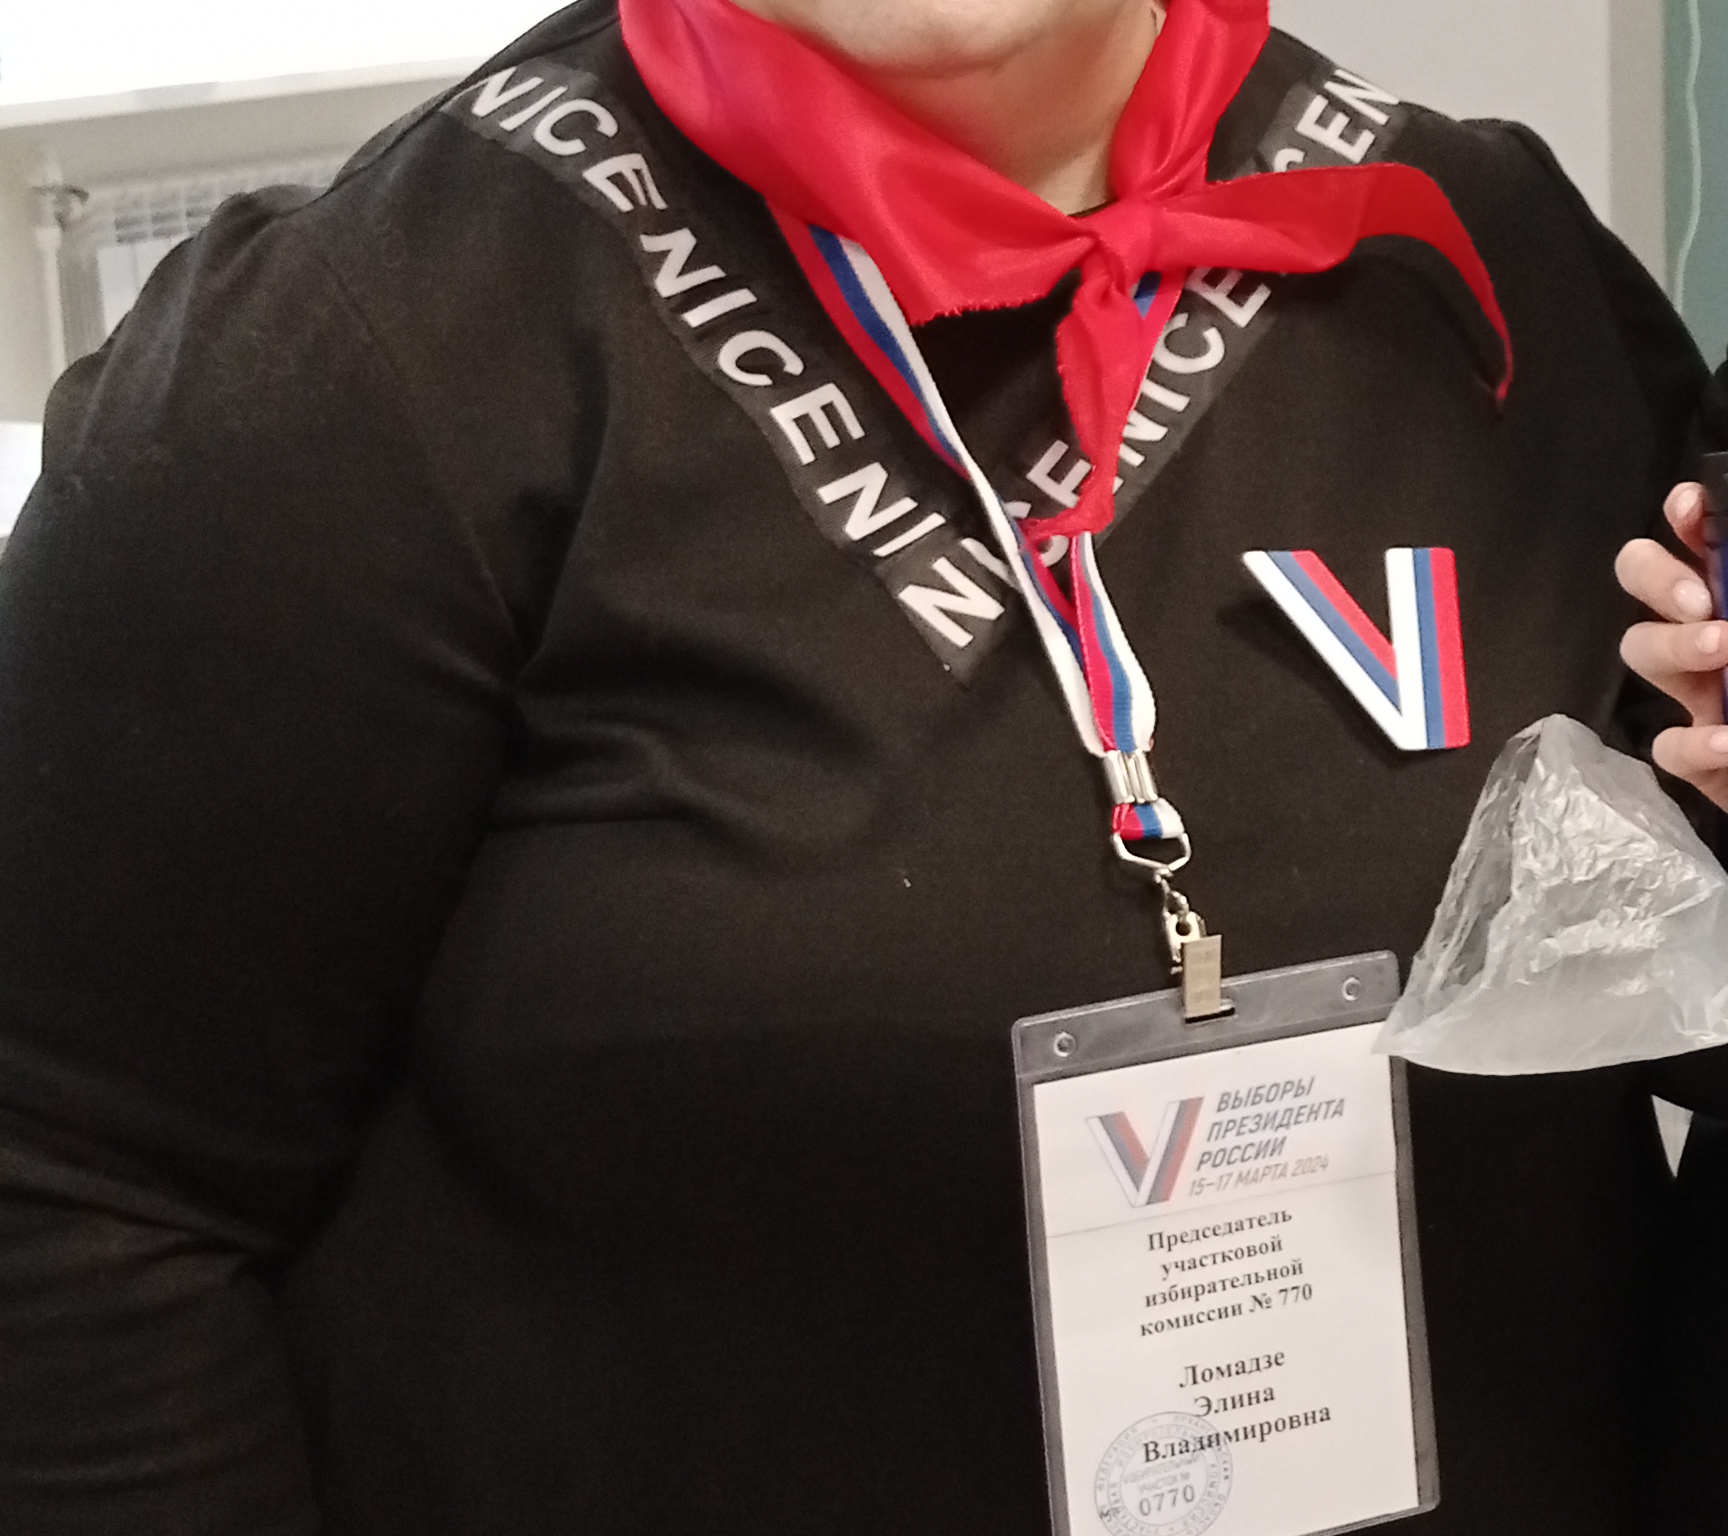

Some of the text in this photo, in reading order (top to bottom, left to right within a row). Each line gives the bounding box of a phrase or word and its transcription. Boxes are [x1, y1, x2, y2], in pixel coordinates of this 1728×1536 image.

[1216, 1076, 1316, 1113] ВЫБОРЫ
[1206, 1098, 1346, 1143] ПРЕЗИДЕНТА
[1196, 1136, 1287, 1172] РОССИИ
[1234, 1163, 1288, 1188] МАРТА
[1290, 1154, 1331, 1178] 2024
[1147, 1209, 1293, 1253] Председатель
[1161, 1233, 1284, 1281] участковой
[1145, 1257, 1304, 1308] избирательной
[1140, 1283, 1313, 1337] комиссии № 770
[1178, 1350, 1286, 1388] Ломадзе
[1193, 1386, 1276, 1418] Элина
[1142, 1406, 1332, 1463] Владимировна
[1138, 1484, 1195, 1517] 0770
